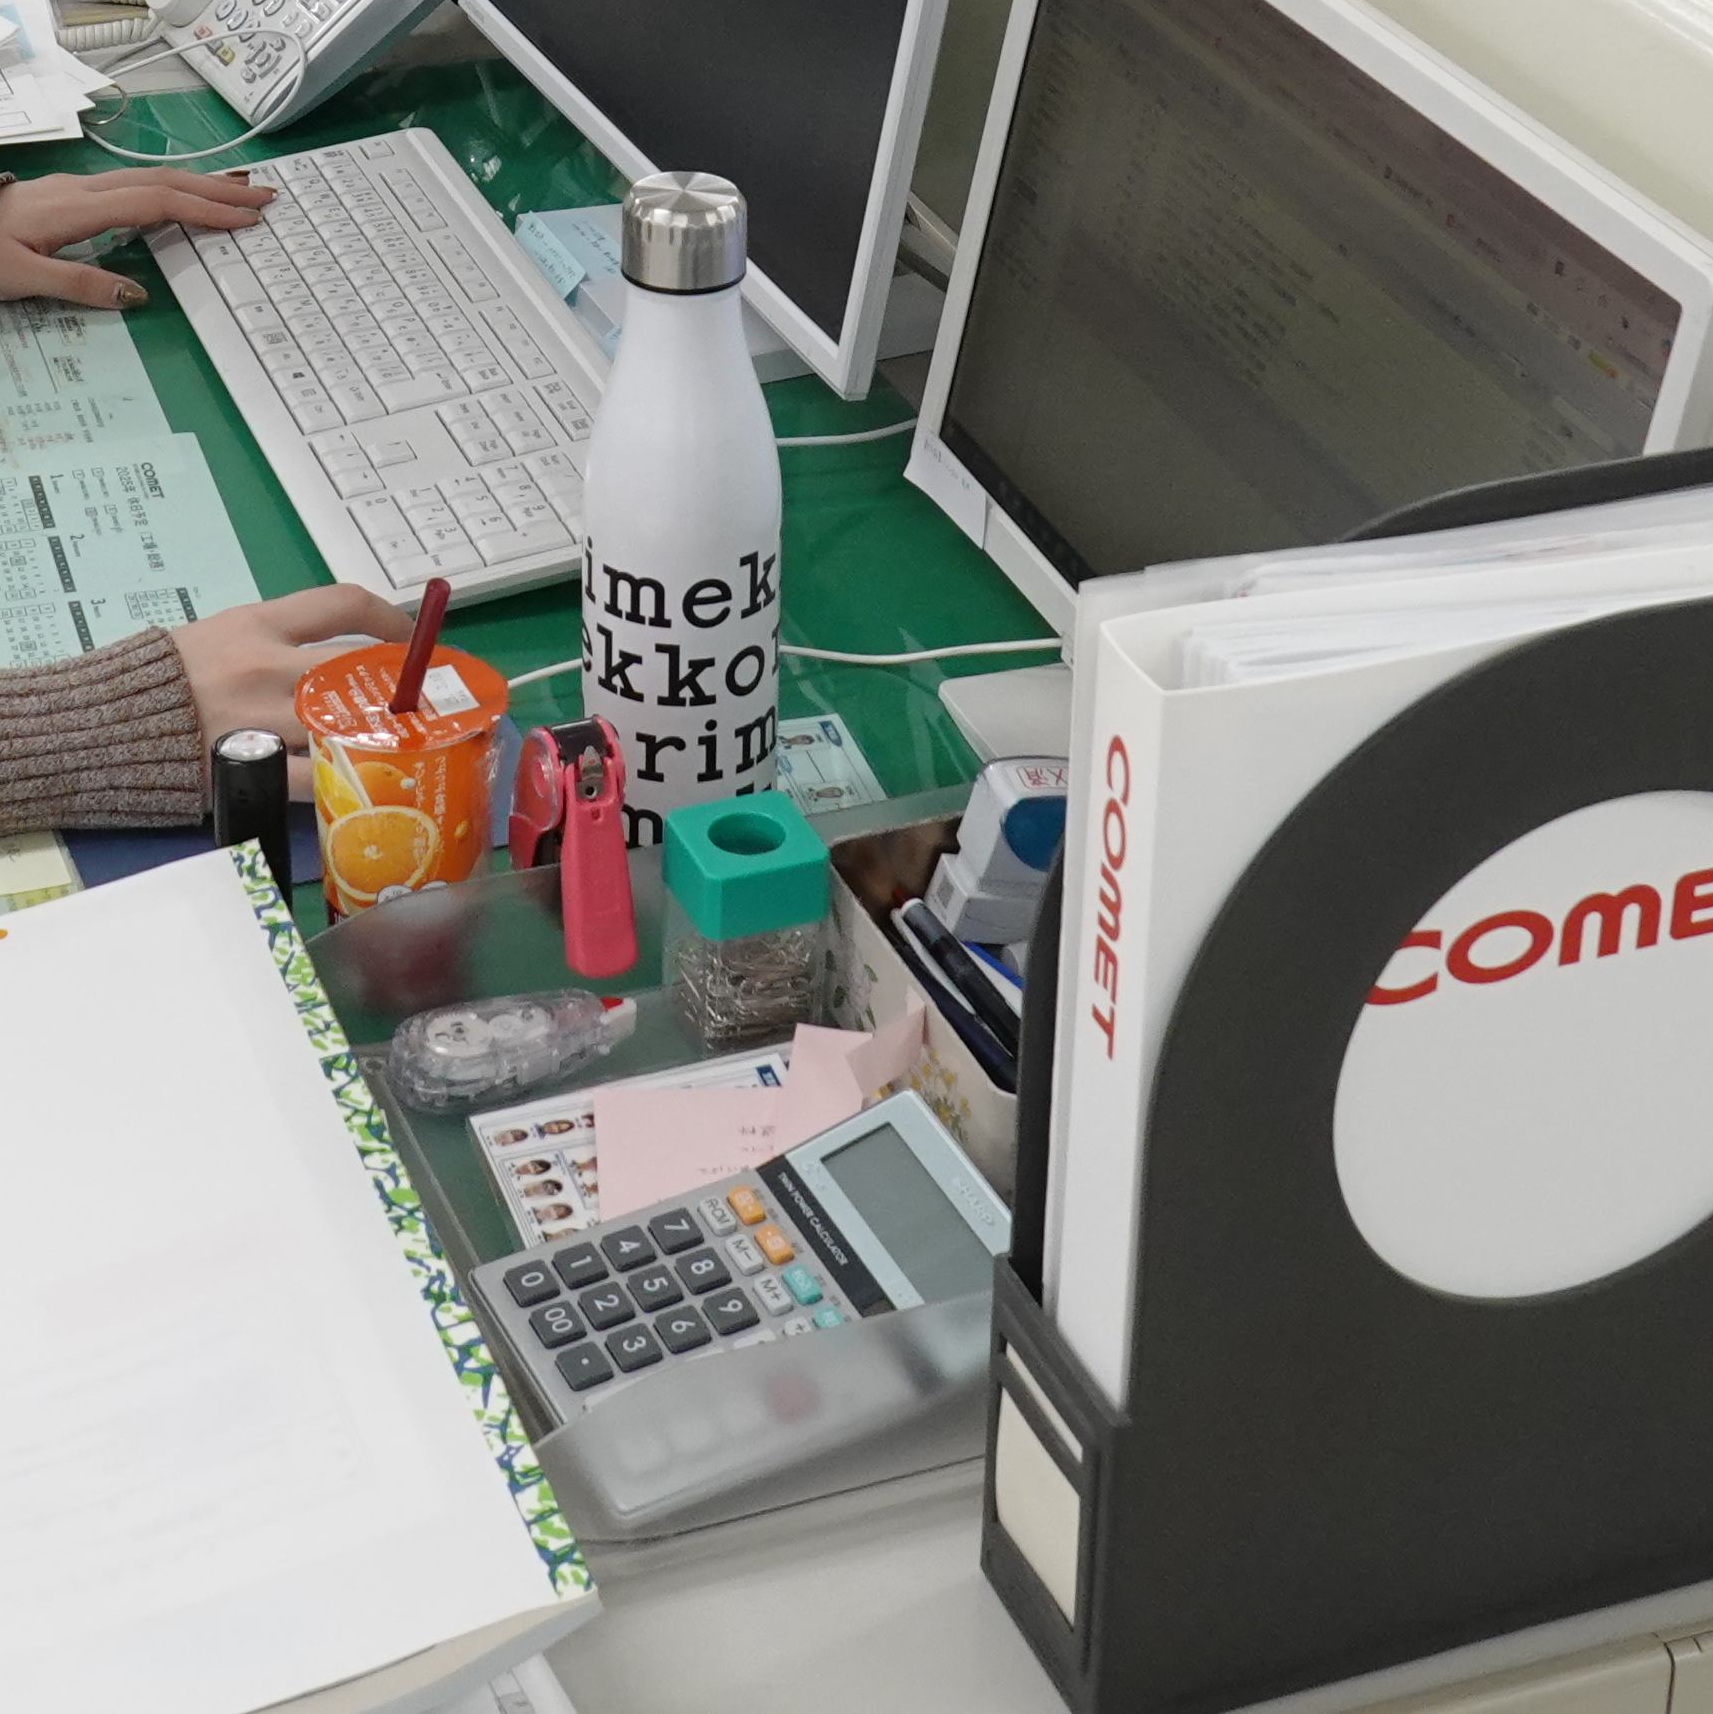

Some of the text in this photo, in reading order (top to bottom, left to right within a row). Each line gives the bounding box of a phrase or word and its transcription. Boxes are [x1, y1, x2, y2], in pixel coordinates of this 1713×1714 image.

[141, 462, 165, 498] COMET
[91, 597, 104, 605] 3
[636, 717, 776, 782] rim
[1089, 732, 1133, 1060] COMET
[664, 1218, 690, 1234] 7
[790, 1189, 815, 1220] POWER
[809, 1215, 849, 1266] CALCULATOR
[618, 1239, 642, 1254] 4
[570, 1255, 593, 1268] 1
[691, 1259, 715, 1275] 8
[521, 1271, 544, 1287] 0
[643, 1276, 668, 1292] 5
[761, 1279, 782, 1301] M+
[593, 1294, 620, 1313] 2
[718, 1298, 744, 1316] 9
[544, 1306, 574, 1333] 00
[671, 1319, 696, 1335] 6
[622, 1336, 647, 1354] 3
